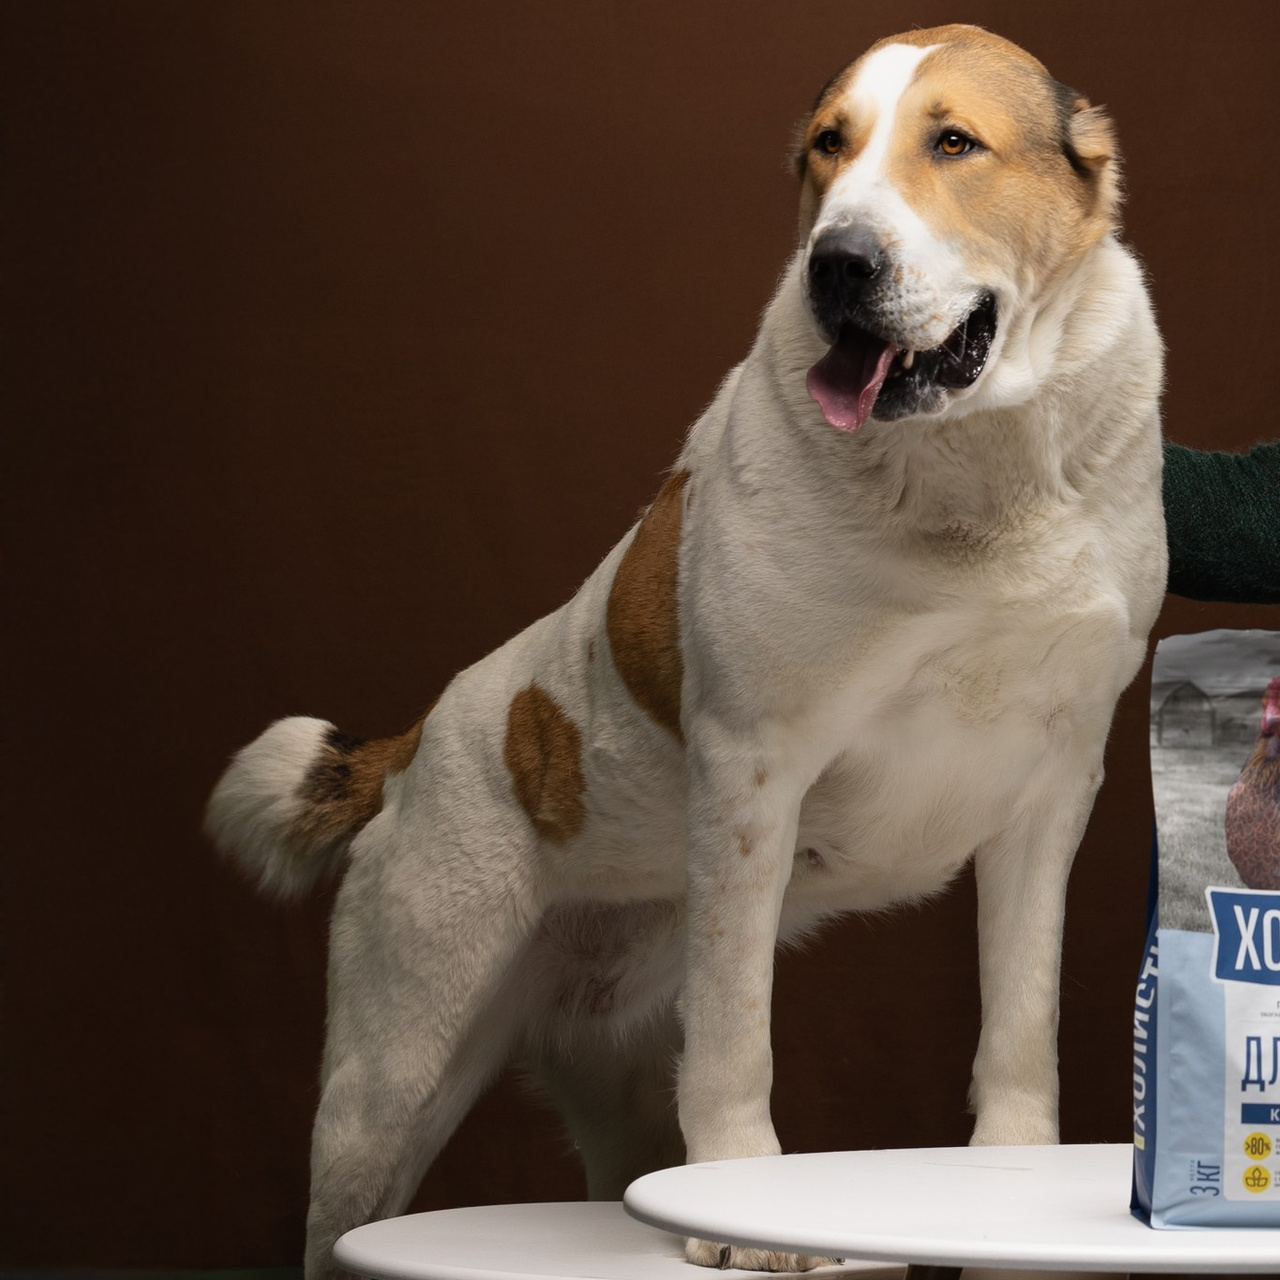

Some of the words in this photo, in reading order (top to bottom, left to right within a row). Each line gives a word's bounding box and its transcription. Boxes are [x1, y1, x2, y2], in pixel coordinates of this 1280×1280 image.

[1244, 1136, 1271, 1156] >80%
[1197, 1160, 1220, 1182] КГ
[1190, 1185, 1220, 1197] 3
